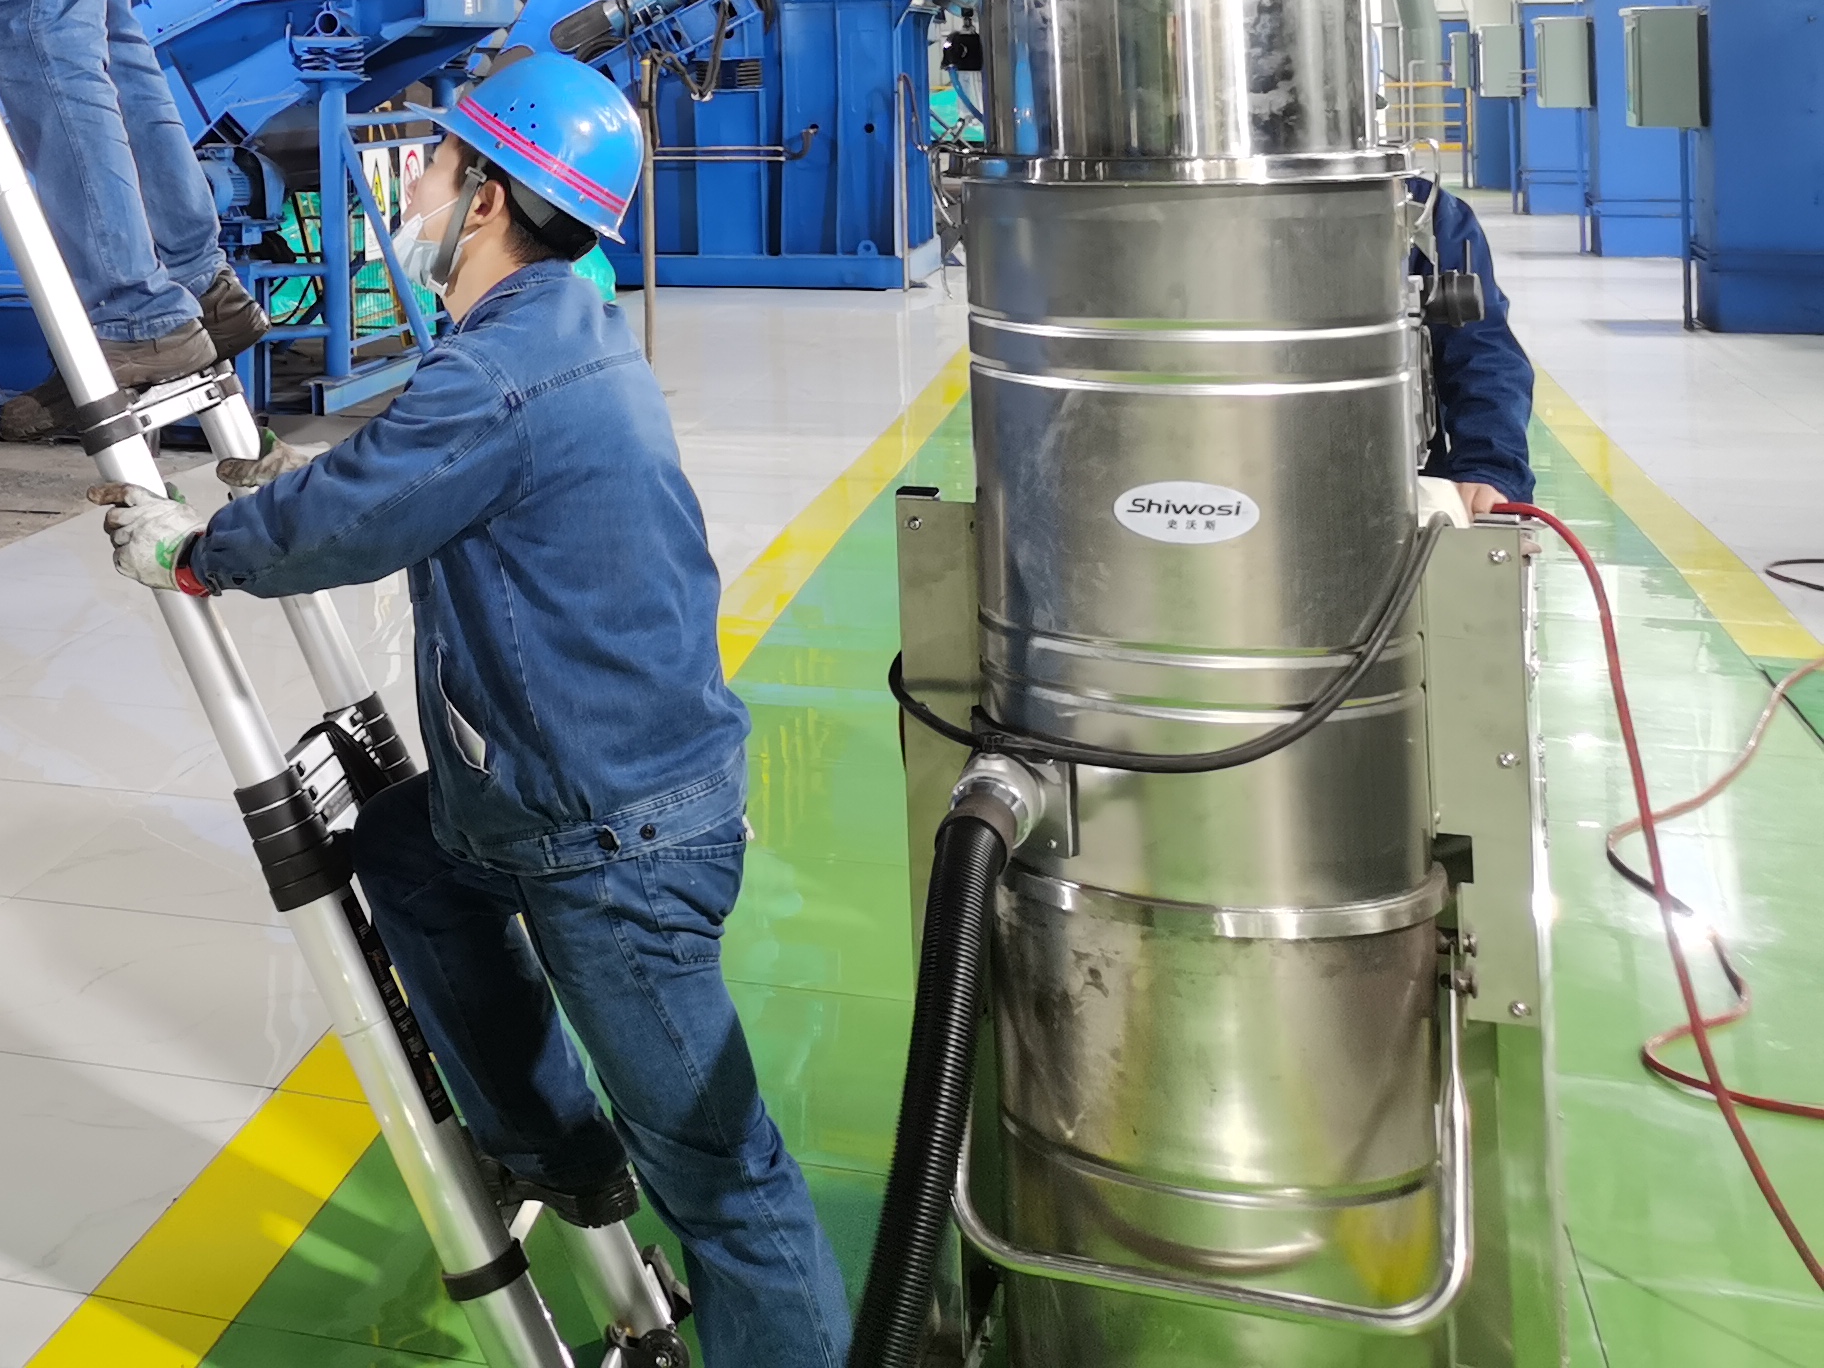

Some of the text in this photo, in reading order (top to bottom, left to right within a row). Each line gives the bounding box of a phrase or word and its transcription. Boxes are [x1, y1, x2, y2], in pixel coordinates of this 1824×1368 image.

[1126, 498, 1242, 516] Shiwosi
[1166, 519, 1216, 532] 史沃斯
